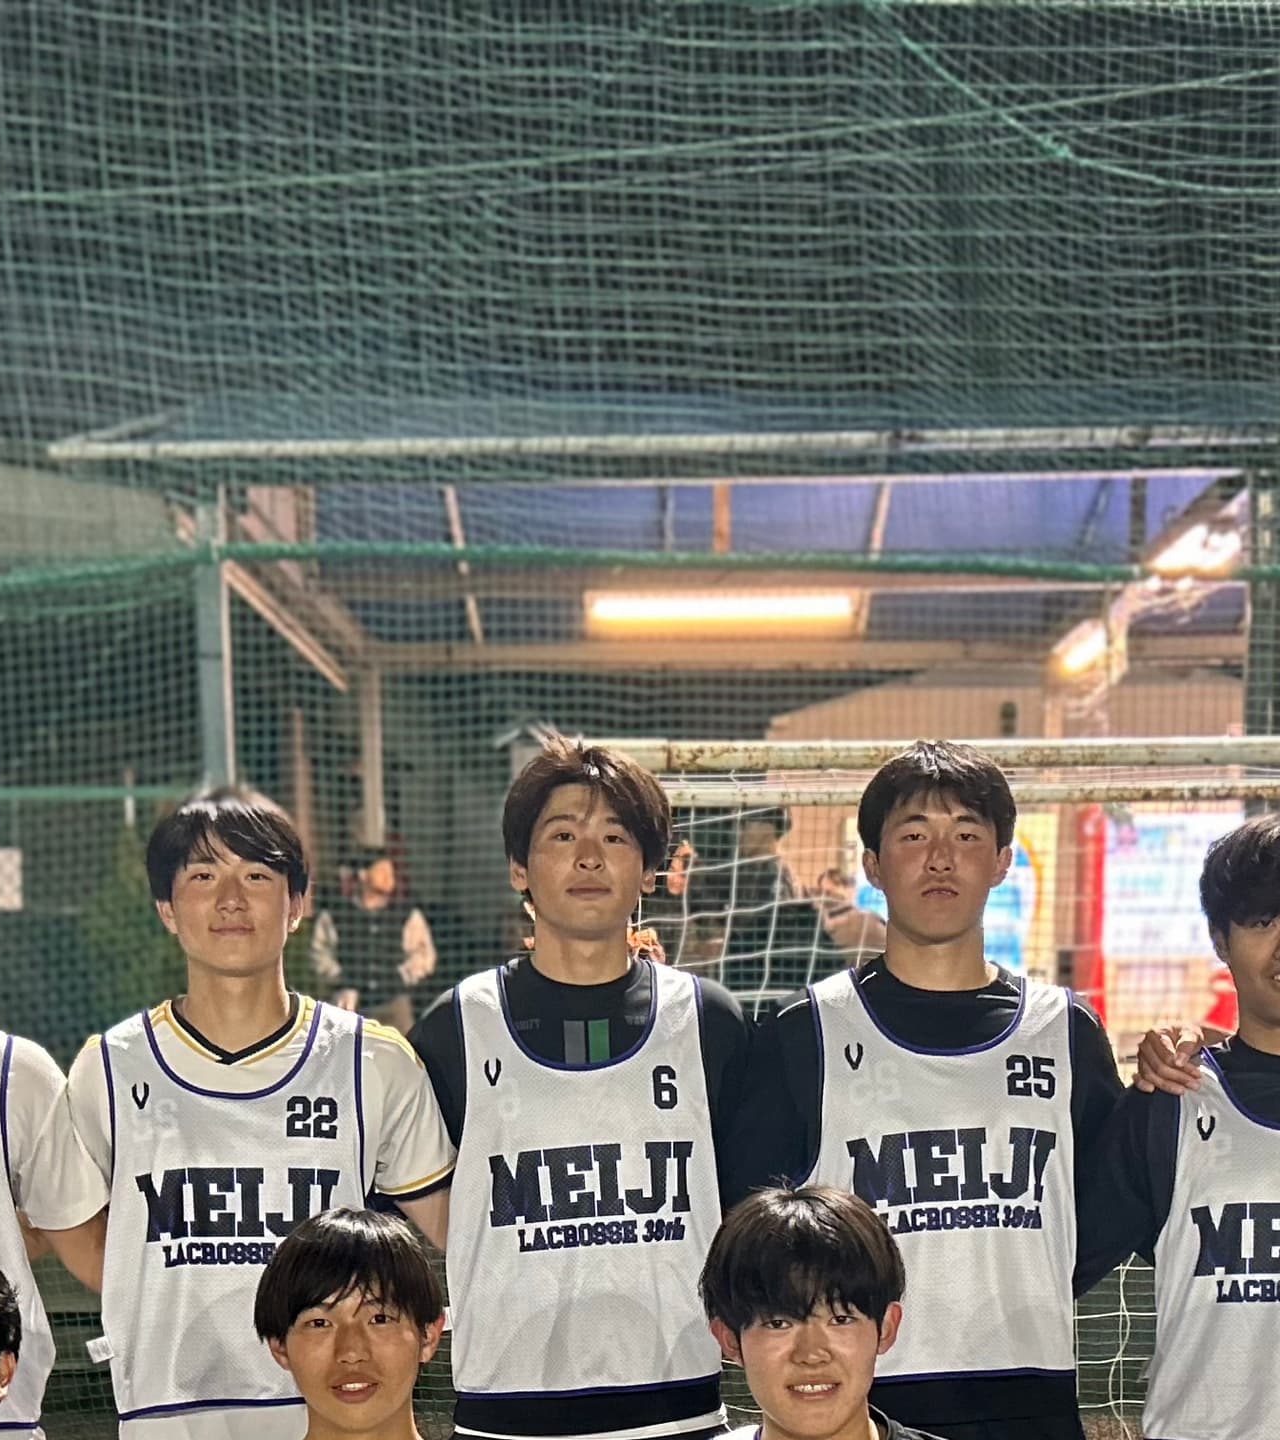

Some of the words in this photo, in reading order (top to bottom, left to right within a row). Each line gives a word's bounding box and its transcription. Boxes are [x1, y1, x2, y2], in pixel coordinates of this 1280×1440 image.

[652, 1065, 678, 1110] 6
[1006, 1054, 1056, 1099] 25
[286, 1096, 338, 1139] 22
[488, 1140, 694, 1227] MEIJI
[846, 1127, 1056, 1209] MEIJI
[135, 1167, 340, 1242] MEIJI
[878, 1205, 999, 1235] LACROSSE
[518, 1219, 638, 1253] LACROSSE
